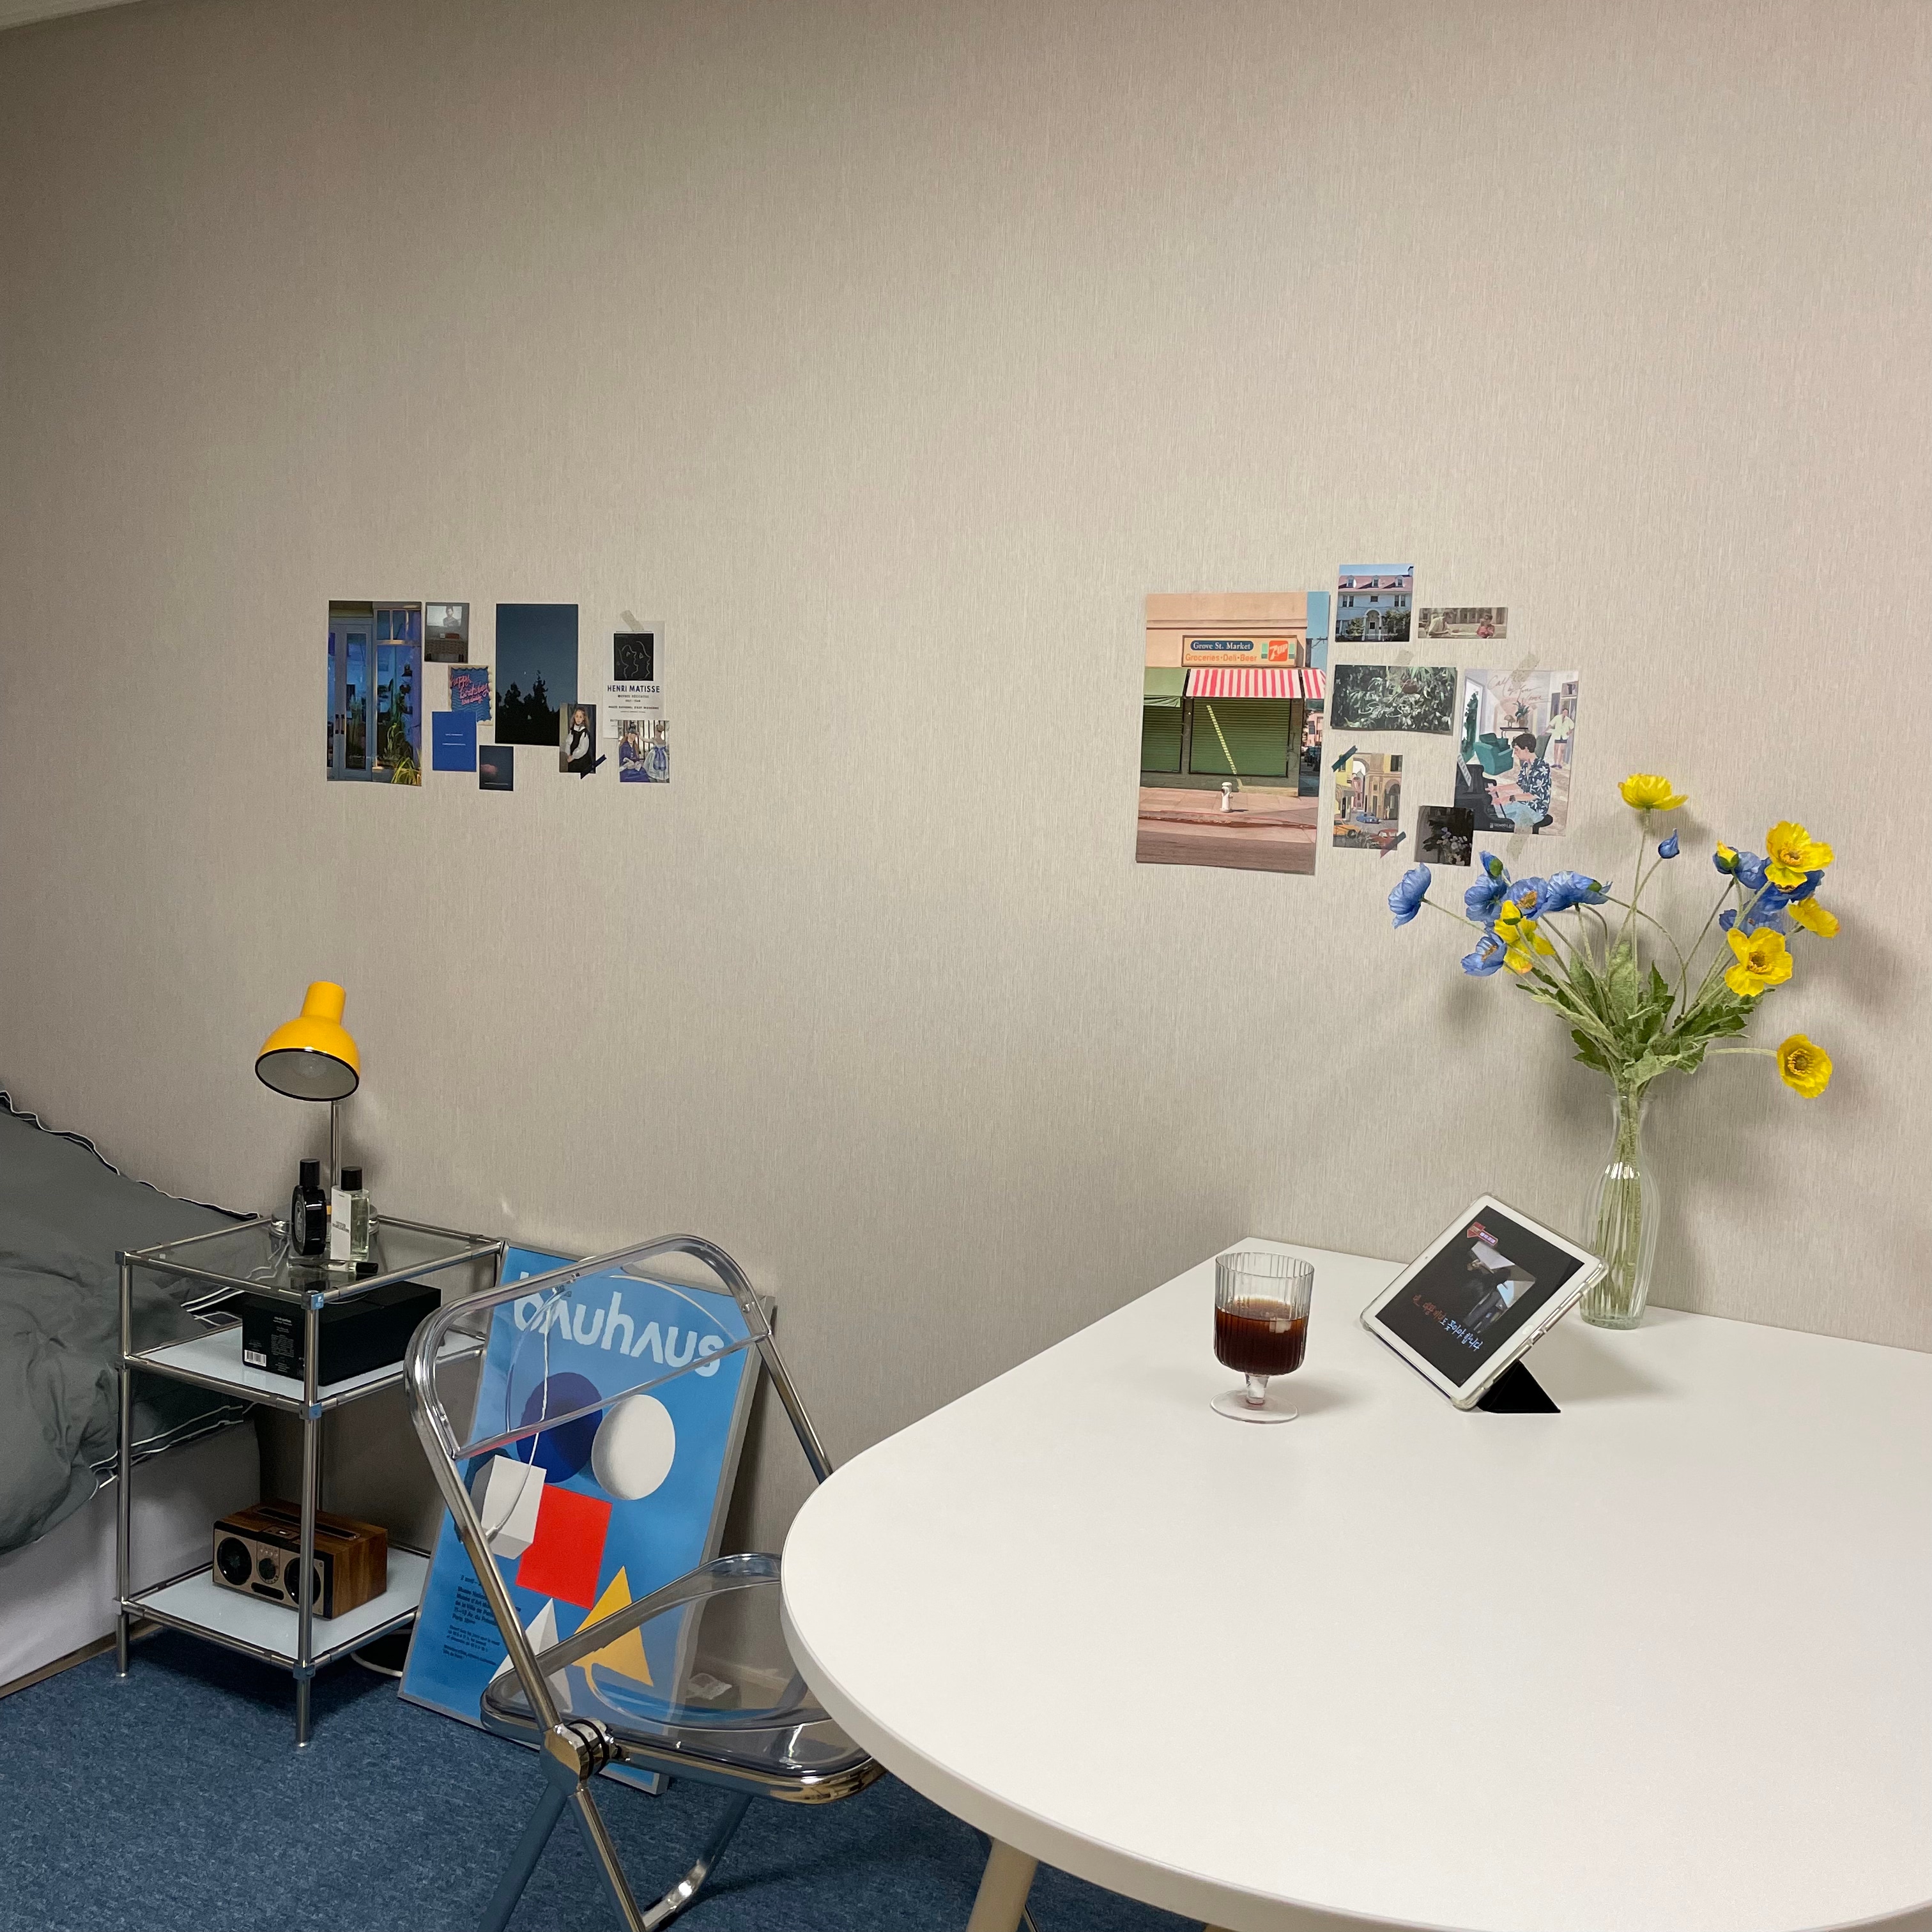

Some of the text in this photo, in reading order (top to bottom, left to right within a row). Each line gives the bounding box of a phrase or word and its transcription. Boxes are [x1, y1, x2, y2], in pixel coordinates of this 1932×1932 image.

[1226, 642, 1251, 650] Market
[607, 684, 660, 693] HENRI MATISSE
[514, 1271, 725, 1377] bauhaus
[1461, 1332, 1483, 1352] 합니다
